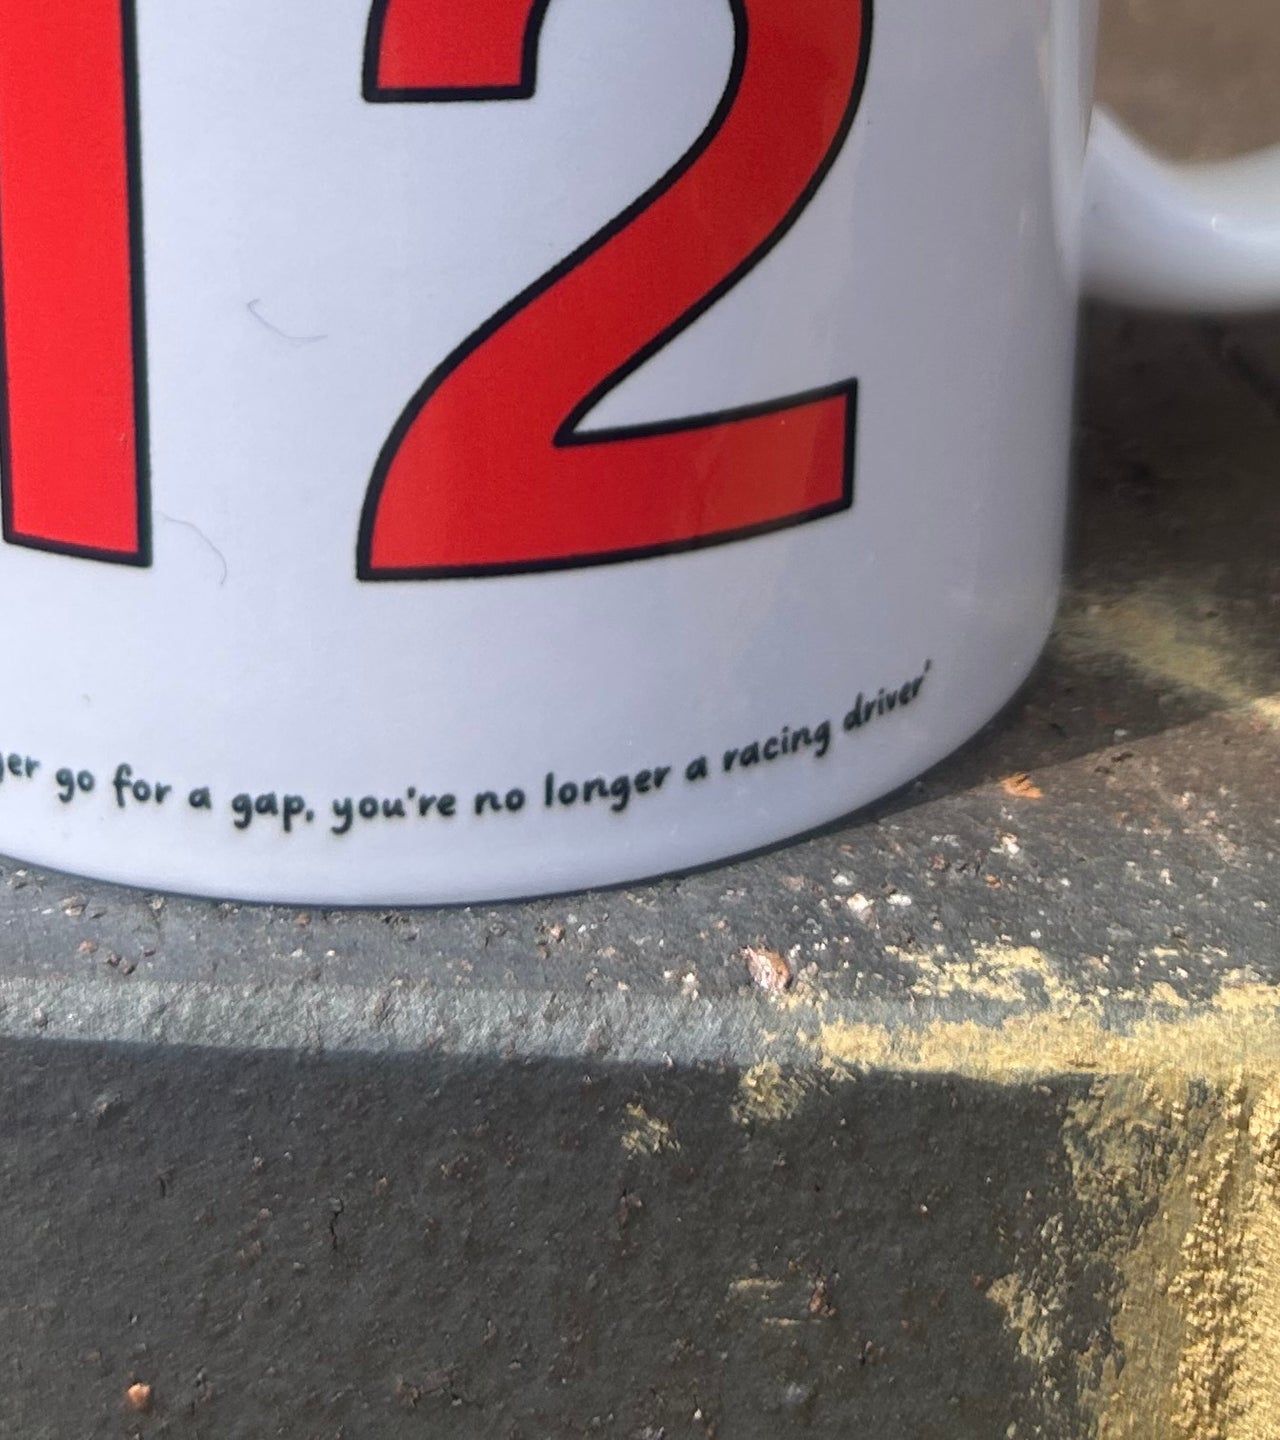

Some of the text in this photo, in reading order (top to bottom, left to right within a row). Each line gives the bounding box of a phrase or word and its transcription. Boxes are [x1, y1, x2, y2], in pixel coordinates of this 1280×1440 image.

[55, 767, 95, 804] go
[113, 763, 173, 808] for
[188, 786, 212, 810] a
[330, 786, 458, 836] you're
[473, 786, 527, 817] no
[543, 763, 673, 814] longer
[683, 755, 710, 784] a
[721, 718, 834, 774] racing
